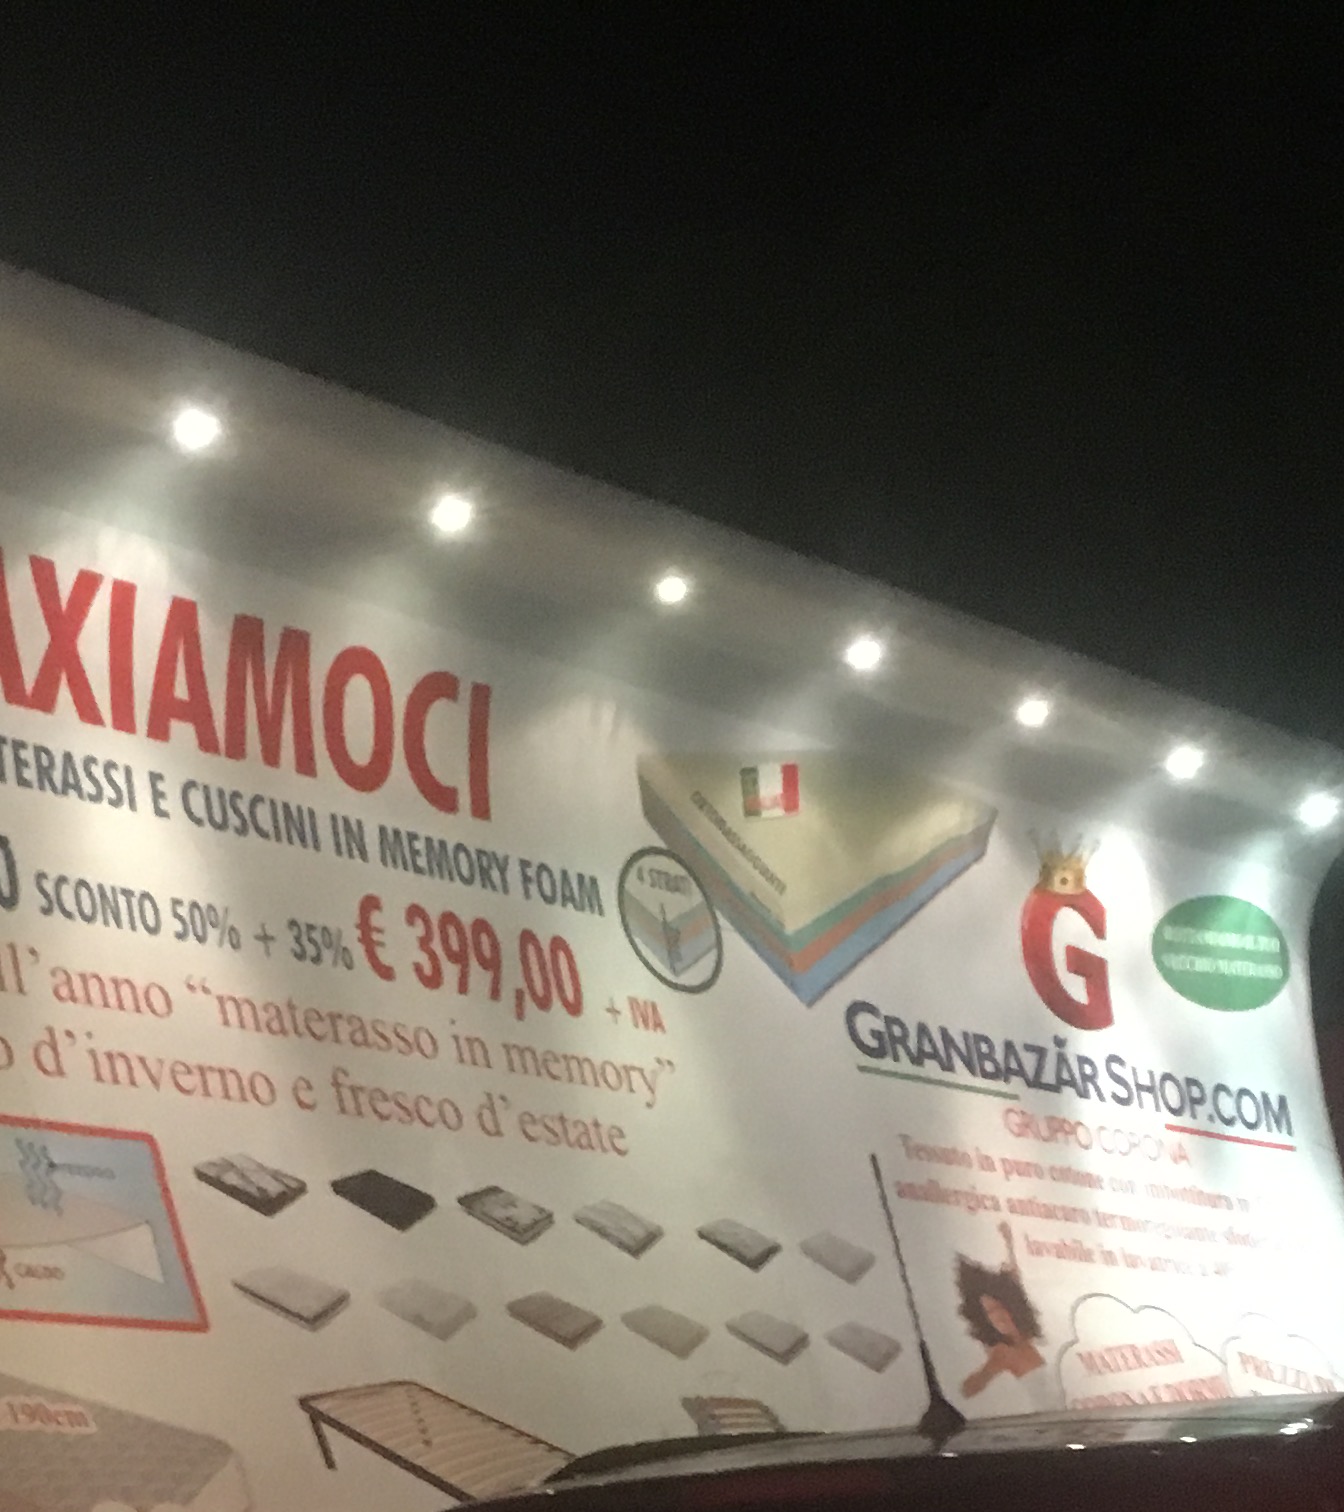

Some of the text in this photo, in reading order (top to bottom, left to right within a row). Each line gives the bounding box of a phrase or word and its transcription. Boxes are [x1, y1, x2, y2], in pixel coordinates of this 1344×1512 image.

[148, 770, 171, 820] E
[181, 778, 322, 853] CUSCINI
[330, 813, 368, 863] IN
[379, 825, 510, 895] MEMORY
[517, 857, 605, 917] FOAM
[35, 871, 162, 936] SCONTO
[171, 897, 241, 951] 50%
[253, 921, 277, 957] +
[287, 918, 355, 970] 35%
[356, 894, 395, 981] €
[406, 903, 584, 1020] 399,00
[628, 996, 667, 1034] IVA
[1020, 888, 1114, 1031] G
[292, 1077, 317, 1111] e
[332, 1067, 463, 1131] fresco
[450, 1019, 489, 1068] in
